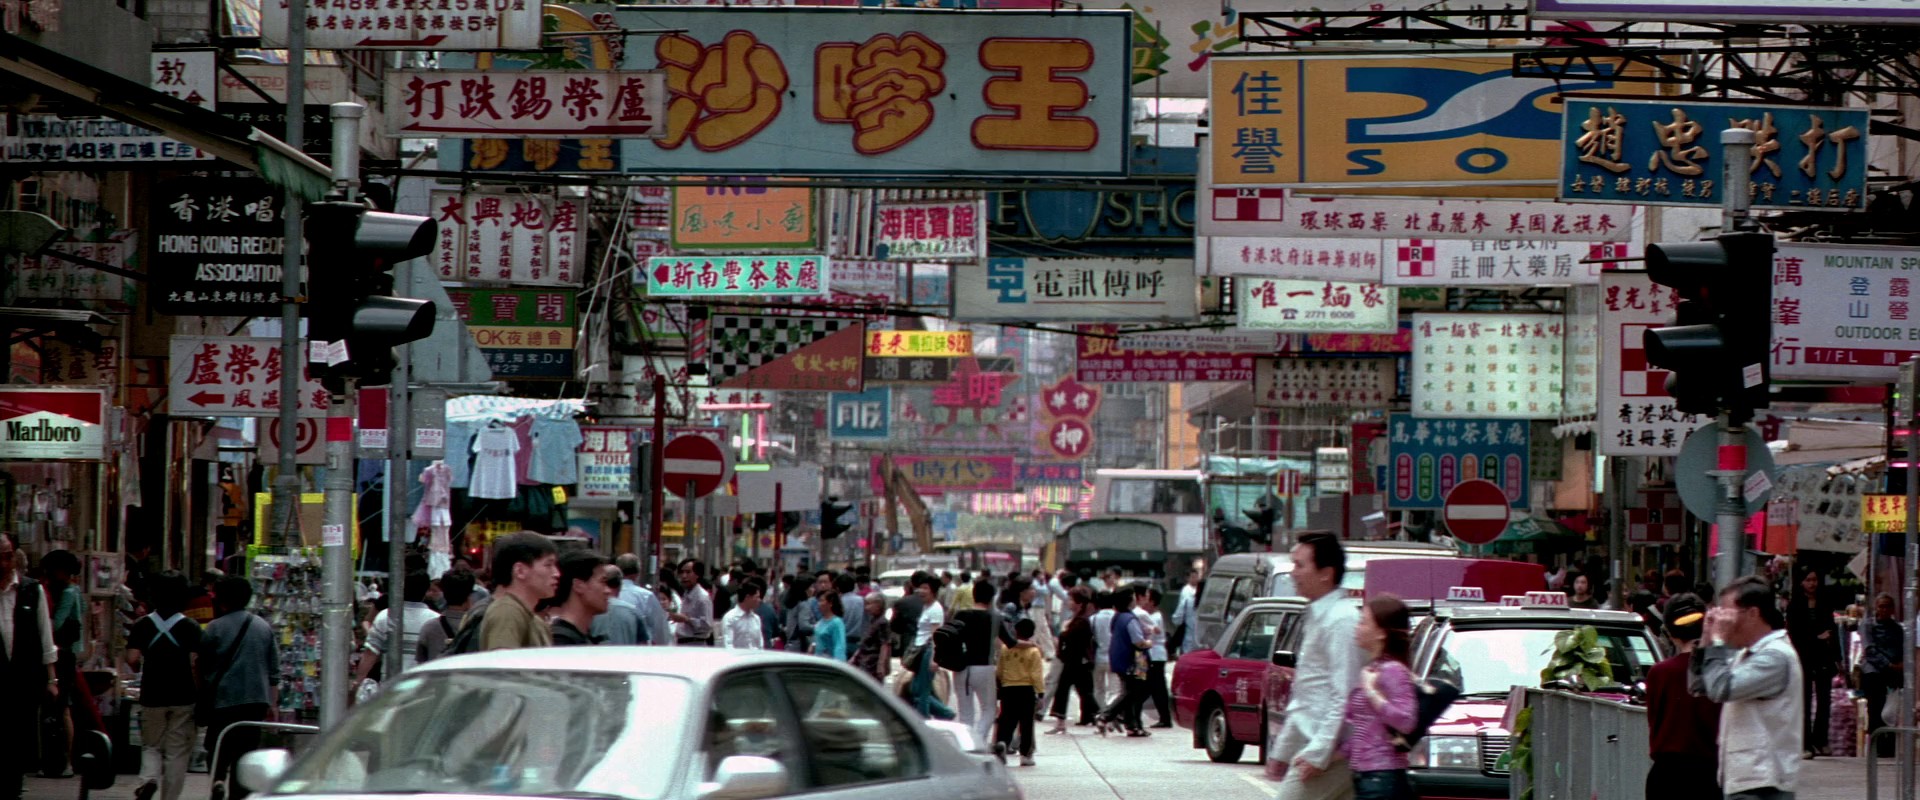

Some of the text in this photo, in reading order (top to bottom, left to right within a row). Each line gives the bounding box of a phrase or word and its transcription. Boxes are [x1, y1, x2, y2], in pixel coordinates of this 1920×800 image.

[1231, 71, 1283, 174] 佳譽
[439, 196, 578, 233] 大興地產
[159, 235, 199, 253] HONG
[201, 236, 238, 253] KONG
[1824, 255, 1893, 269] MOUNTAIN
[1032, 270, 1165, 299] 電訊傳呼
[1605, 285, 1645, 311] 星光
[470, 329, 563, 346] OK夜總會
[1835, 325, 1902, 341] OUTDOOR
[184, 343, 313, 386] 盧榮錫
[6, 419, 81, 442] Marlboro
[1451, 589, 1481, 599] TAXI
[1503, 598, 1522, 607] TA
[1528, 594, 1564, 605] TAXI
